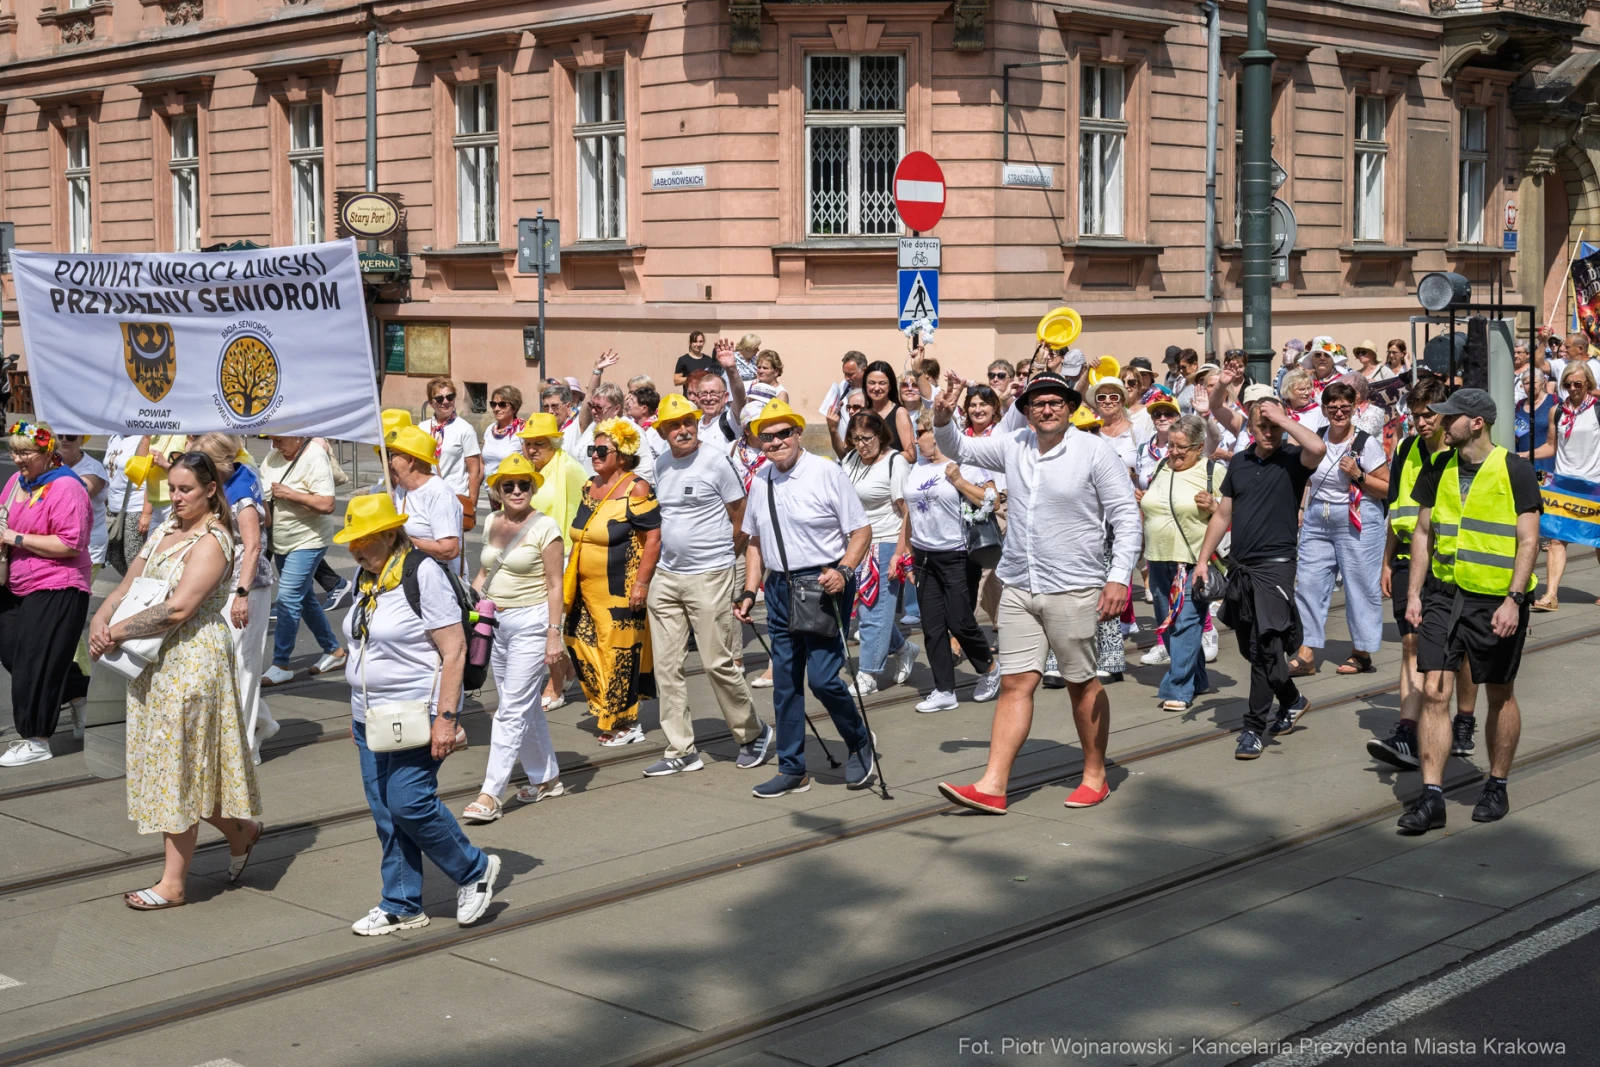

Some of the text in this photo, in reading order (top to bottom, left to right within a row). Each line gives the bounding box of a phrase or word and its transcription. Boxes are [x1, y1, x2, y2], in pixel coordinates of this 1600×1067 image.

[653, 176, 703, 186] JABŁONOWSKICH
[350, 212, 385, 226] Stary Port
[915, 241, 939, 250] dotyczy
[54, 252, 327, 287] POWIAT WROCŁAWSKI
[359, 260, 396, 268] WERNA
[50, 282, 341, 314] PRZYJAZNY SENIOROM
[221, 320, 273, 339] RADA SENIORÓW
[138, 408, 172, 418] POWIAT
[212, 393, 232, 427] POWIATU
[125, 420, 181, 430] WROCŁAWSKI
